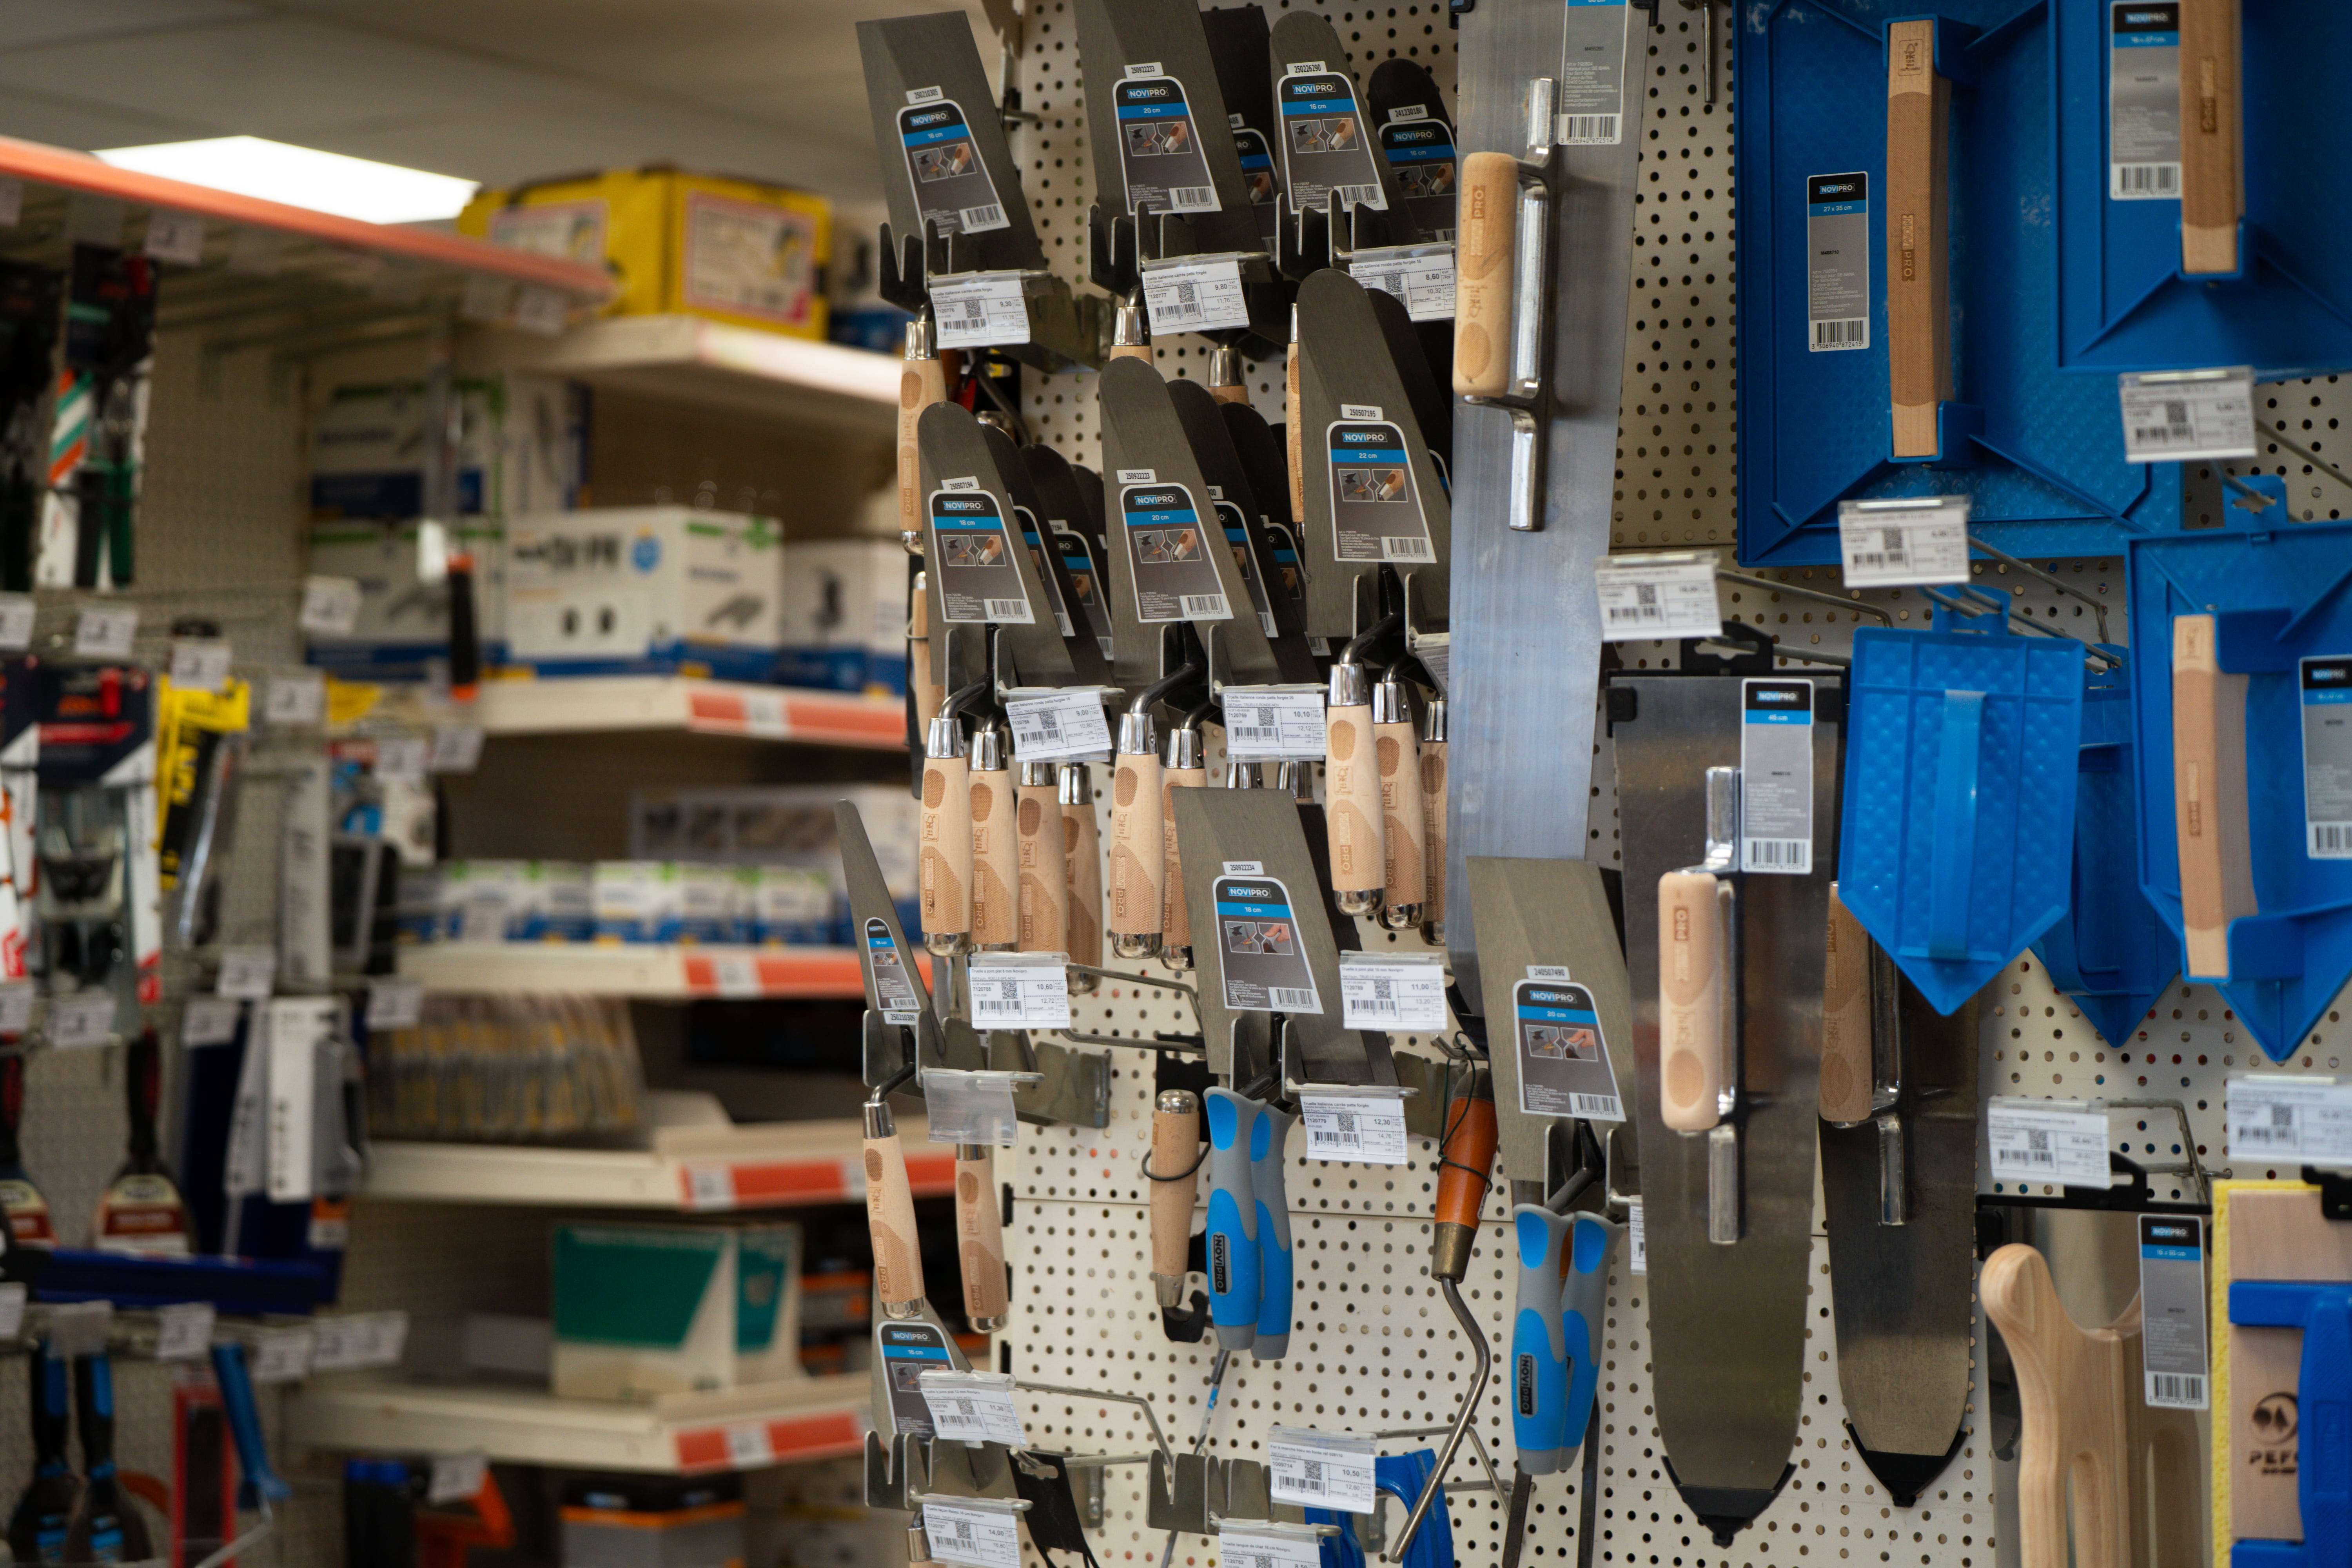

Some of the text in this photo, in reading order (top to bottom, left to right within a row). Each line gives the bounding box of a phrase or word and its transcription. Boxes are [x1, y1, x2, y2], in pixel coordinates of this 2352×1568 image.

[1294, 64, 1321, 73] 250226290
[1129, 89, 1166, 97] NOVIPRO
[1295, 84, 1333, 93] NOVIPRO
[912, 113, 947, 124] NOVIPRO
[1395, 131, 1432, 140] NOVIPRO
[1903, 217, 1912, 278] NOVIPRO
[1137, 495, 1174, 504] NOVIPRO
[926, 858, 934, 914] NOVIPRO
[975, 871, 984, 926] NOVIPRO
[1023, 885, 1031, 938] NOVIPRO
[1533, 992, 1573, 1001] NOVIPRO
[875, 1237, 887, 1290] NOVIPRO
[1214, 1238, 1224, 1290] NOVIPRO
[1521, 1359, 1532, 1412] NOVIPRO
